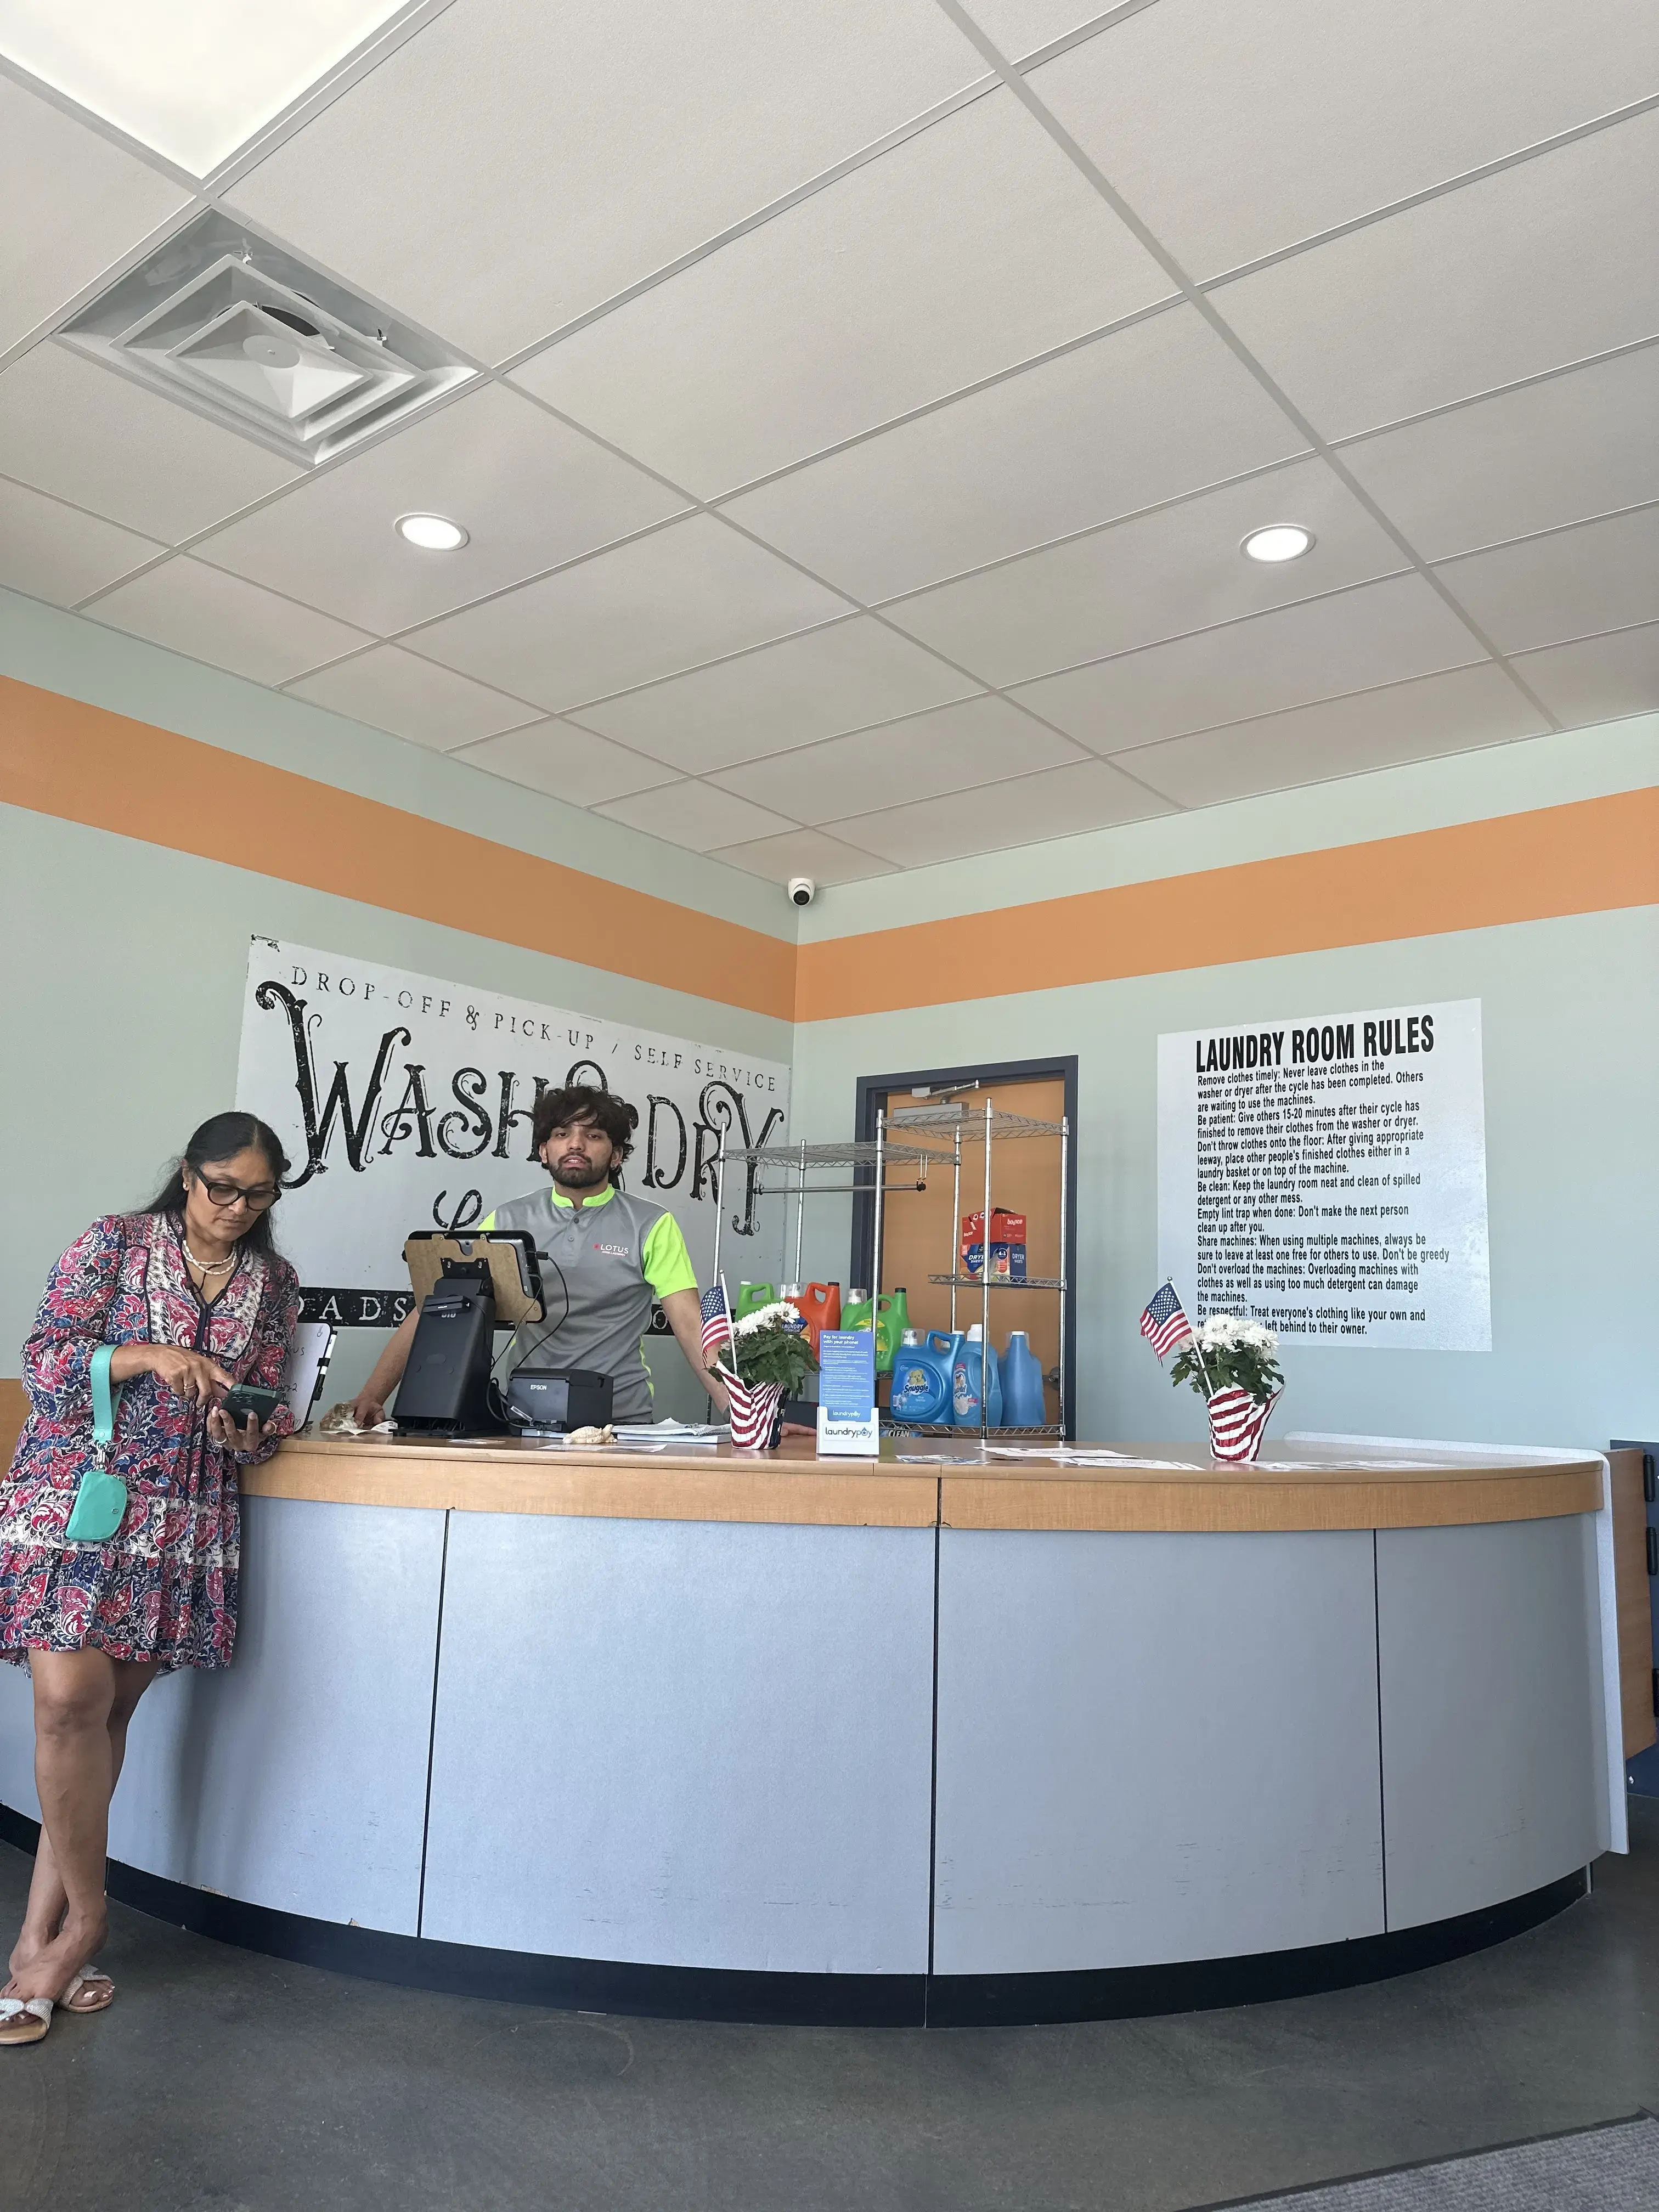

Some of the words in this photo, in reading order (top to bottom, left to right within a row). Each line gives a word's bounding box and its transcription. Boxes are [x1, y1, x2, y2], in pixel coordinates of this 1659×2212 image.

[291, 966, 451, 1017] DROP-OFF
[466, 1005, 479, 1030] &
[494, 1013, 595, 1049] PICK-UP
[611, 1042, 618, 1054] /
[634, 1045, 683, 1069] SELF
[695, 1059, 776, 1092] SERVICE
[1196, 1031, 1284, 1073] LAUNDRY
[1292, 1023, 1354, 1063] ROOM
[1363, 1014, 1434, 1057] RULES
[1197, 1075, 1225, 1086] Remove
[1227, 1071, 1254, 1084] clothes
[1255, 1068, 1280, 1082] timely:
[1283, 1066, 1305, 1079] Never
[1307, 1065, 1327, 1076] leave
[1329, 1062, 1358, 1075] clothes
[1361, 1062, 1369, 1072] in
[1371, 1058, 1385, 1071] the
[1197, 1087, 1222, 1099] washer
[1224, 1088, 1232, 1097] or
[1234, 1085, 1253, 1099] dryer
[1255, 1082, 1272, 1094] after
[1274, 1081, 1286, 1093] the
[1288, 1079, 1308, 1094] cycle
[1311, 1078, 1325, 1090] has
[1327, 1077, 1346, 1089] been
[1348, 1072, 1393, 1088] completed.
[1395, 1070, 1424, 1084] Others
[1197, 1103, 1209, 1113] are
[1210, 1099, 1236, 1113] waiting
[1238, 1098, 1245, 1109] to
[1248, 1099, 1261, 1109] use
[1262, 1096, 1275, 1108] the
[1277, 1093, 1316, 1107] machines.
[1197, 1114, 1207, 1126] Be
[1209, 1113, 1235, 1127] patient:
[1237, 1111, 1254, 1123] Give
[1256, 1109, 1280, 1122] others
[1282, 1107, 1302, 1120] 15-20
[1305, 1105, 1336, 1118] minutes
[1338, 1103, 1357, 1116] after
[1358, 1102, 1378, 1115] their
[1380, 1100, 1402, 1116] cycle
[1404, 1099, 1420, 1111] has
[1197, 1126, 1226, 1139] finished
[1227, 1126, 1235, 1137] to
[1237, 1126, 1263, 1136] remove
[1265, 1122, 1284, 1135] their
[1285, 1121, 1313, 1133] clothes
[1316, 1119, 1334, 1131] from
[1336, 1118, 1349, 1131] the
[1351, 1116, 1381, 1129] washer
[1383, 1118, 1392, 1127] or
[1394, 1114, 1418, 1130] dryer.
[1197, 1140, 1216, 1152] Don't
[1217, 1139, 1239, 1151] throw
[1240, 1137, 1267, 1150] clothes
[1269, 1137, 1286, 1148] onto
[1288, 1135, 1301, 1147] the
[1302, 1134, 1324, 1146] floor:
[1326, 1132, 1346, 1145] After
[1348, 1133, 1373, 1147] giving
[1376, 1128, 1424, 1145] appropriate
[642, 1080, 784, 1237] DRY
[1197, 1166, 1224, 1181] laundry
[1226, 1165, 1250, 1177] basket
[1251, 1167, 1260, 1177] or
[1262, 1166, 1272, 1176] on
[1273, 1164, 1286, 1178] top
[1288, 1163, 1297, 1175] of
[1298, 1162, 1311, 1175] the
[1313, 1161, 1349, 1174] machine.
[1197, 1181, 1207, 1192] Be
[1208, 1180, 1230, 1192] clean:
[1232, 1179, 1251, 1193] Keep
[1252, 1178, 1265, 1190] the
[1267, 1177, 1295, 1192] laundry
[1297, 1178, 1318, 1189] room
[1320, 1176, 1338, 1188] neat
[1340, 1175, 1355, 1188] and
[1357, 1174, 1379, 1187] clean
[1381, 1173, 1390, 1186] of
[1392, 1172, 1420, 1188] spilled
[1197, 1193, 1231, 1208] detergent
[1232, 1195, 1241, 1205] or
[1243, 1195, 1256, 1207] any
[1258, 1192, 1278, 1204] other
[1280, 1193, 1303, 1203] mess.
[1197, 1207, 1220, 1222] Empty
[1221, 1206, 1234, 1218] lint
[1235, 1207, 1250, 1221] trap
[1252, 1206, 1272, 1218] when
[1274, 1205, 1295, 1218] done:
[1298, 1204, 1319, 1217] Don't
[1321, 1204, 1342, 1217] make
[1344, 1204, 1357, 1216] the
[1359, 1204, 1378, 1216] next
[1380, 1205, 1409, 1218] person
[1197, 1221, 1216, 1233] clean
[1218, 1223, 1228, 1235] up
[1229, 1220, 1247, 1232] after
[1248, 1222, 1265, 1235] you.
[600, 1244, 629, 1254] LOTUS
[1197, 1234, 1218, 1246] Share
[1220, 1234, 1257, 1246] machines:
[1259, 1234, 1280, 1246] When
[1282, 1236, 1304, 1249] using
[1306, 1233, 1338, 1248] multiple
[1340, 1232, 1381, 1247] machines,
[1384, 1232, 1413, 1248] always
[1415, 1232, 1426, 1245] be
[1197, 1262, 1217, 1274] Don't
[1218, 1262, 1250, 1274] overload
[1251, 1262, 1264, 1274] the
[1266, 1262, 1305, 1274] machines:
[1307, 1262, 1356, 1278] Overloading
[1358, 1262, 1398, 1275] machines
[1400, 1262, 1418, 1275] with
[1197, 1276, 1223, 1288] clothes
[1225, 1279, 1234, 1288] as
[1235, 1276, 1251, 1289] well
[1253, 1279, 1262, 1289] as
[1264, 1279, 1285, 1292] using
[1287, 1277, 1301, 1289] too
[1302, 1277, 1324, 1289] much
[1327, 1277, 1365, 1293] detergent
[1368, 1280, 1383, 1290] can
[1385, 1277, 1418, 1293] damage
[1197, 1290, 1209, 1302] the
[1210, 1290, 1248, 1302] machines.
[904, 1384, 929, 1393] Snuggle
